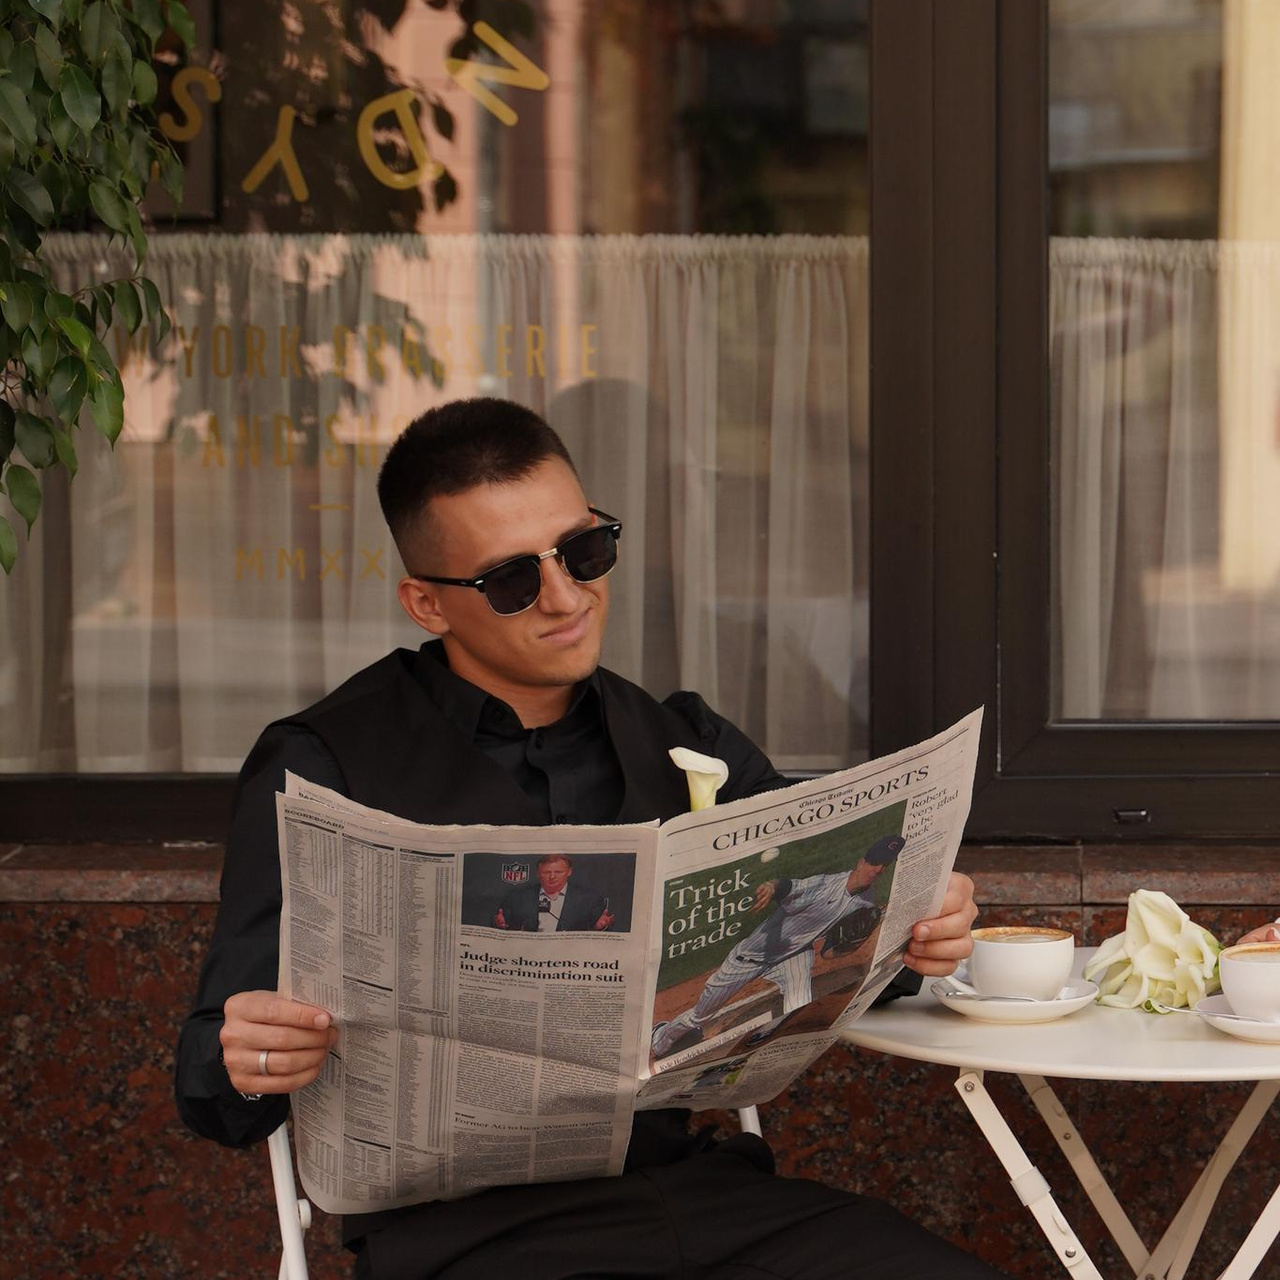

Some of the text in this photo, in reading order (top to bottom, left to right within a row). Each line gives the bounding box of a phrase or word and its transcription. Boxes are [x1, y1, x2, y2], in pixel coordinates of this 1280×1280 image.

[179, 324, 302, 380] YORK
[333, 324, 598, 381] BRASSERIE
[203, 414, 295, 468] AND
[712, 765, 930, 851] CHICAGO SPORTS
[911, 788, 947, 809] Robert
[937, 789, 959, 810] glad
[285, 808, 345, 830] SCOREBOARD
[907, 822, 918, 831] to
[505, 870, 526, 880] NFL
[669, 869, 751, 910] Trick
[668, 896, 754, 935] of the
[668, 920, 742, 959] trade
[459, 951, 619, 970] Judge shortens road
[459, 961, 474, 972] in
[478, 964, 593, 982] discrimination
[595, 972, 625, 983] suit
